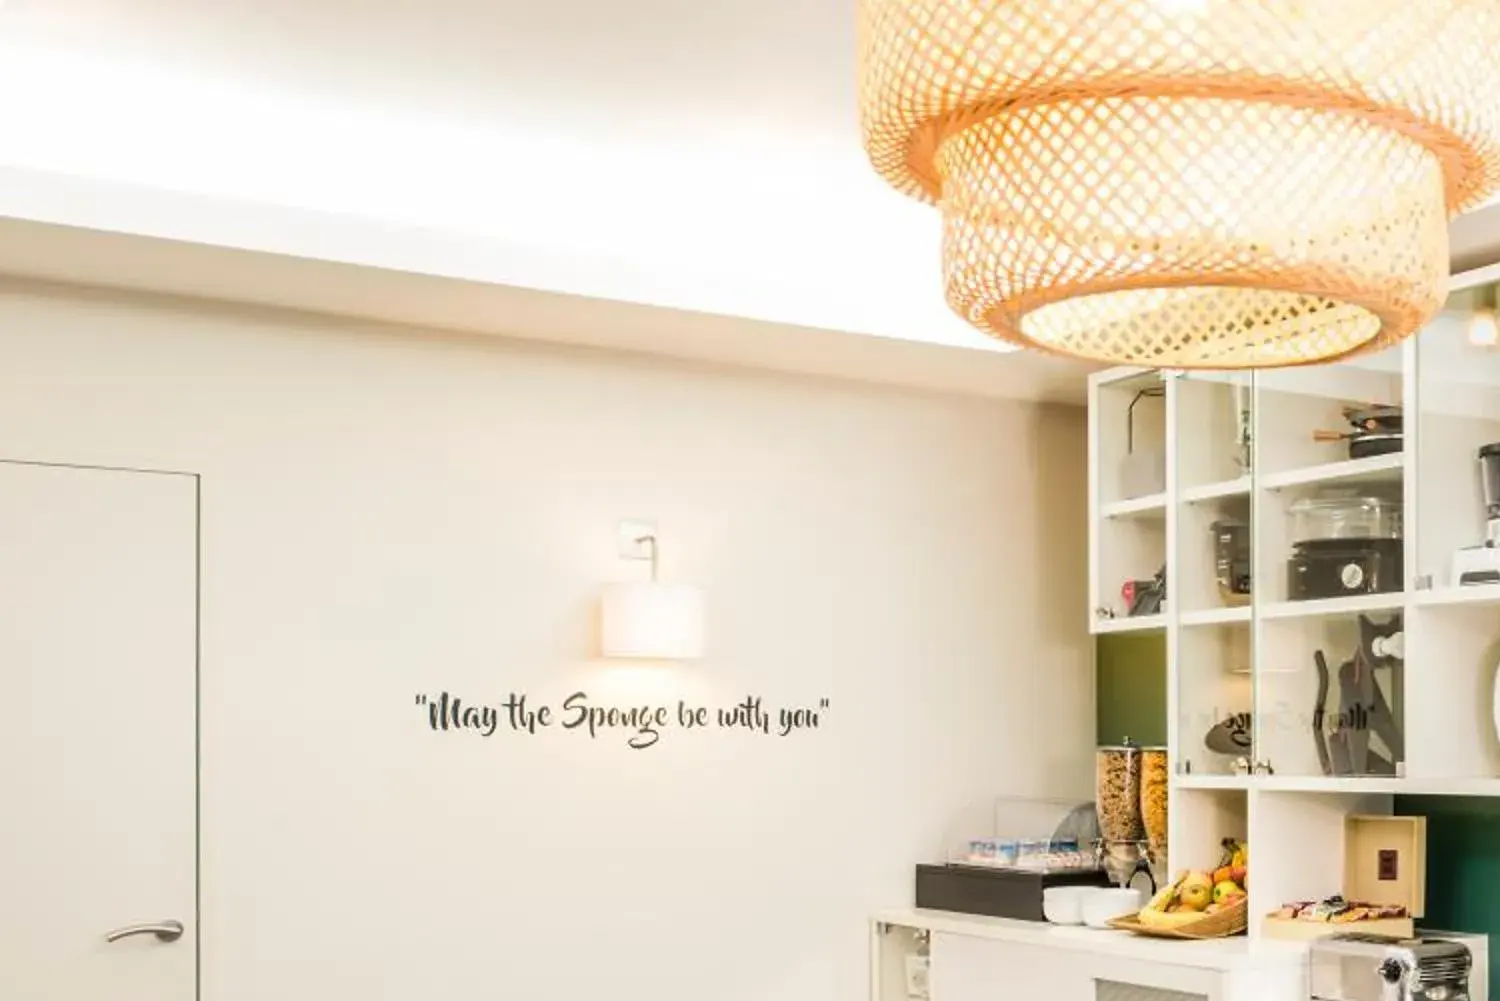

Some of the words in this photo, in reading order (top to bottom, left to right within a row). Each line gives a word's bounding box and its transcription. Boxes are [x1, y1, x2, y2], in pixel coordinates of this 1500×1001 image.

[501, 692, 551, 735] the
[561, 691, 668, 749] Sponge
[677, 700, 708, 729] be
[717, 695, 769, 735] with
